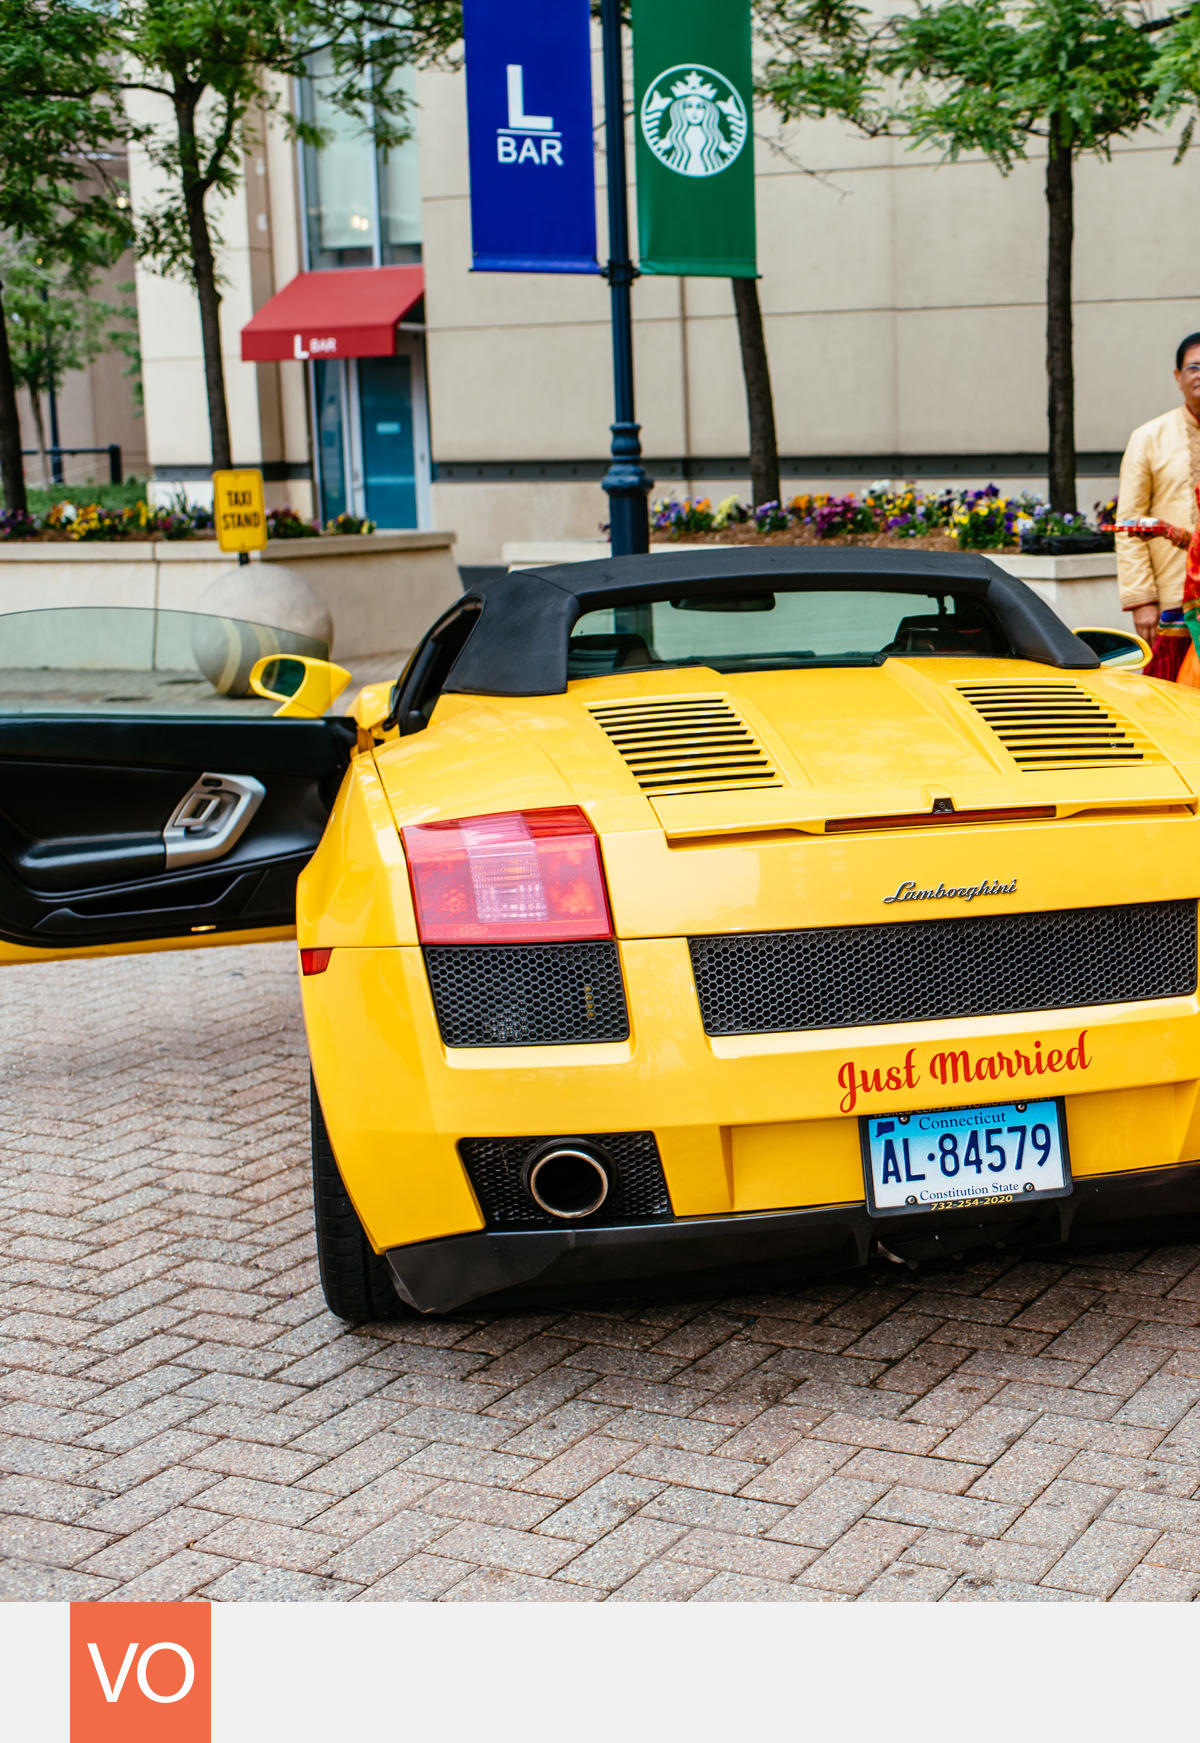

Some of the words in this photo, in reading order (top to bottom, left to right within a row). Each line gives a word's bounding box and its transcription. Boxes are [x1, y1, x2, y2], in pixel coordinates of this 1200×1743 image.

[506, 64, 553, 130] L
[497, 136, 563, 165] BAR
[294, 334, 309, 359] L
[227, 491, 252, 506] TAXI
[222, 513, 260, 530] STAND
[883, 878, 1017, 903] Lamborghini
[838, 1049, 920, 1113] Just
[930, 1030, 1092, 1085] Married
[919, 1112, 1006, 1130] Connecticut
[920, 1187, 988, 1200] Constitution
[992, 1182, 1019, 1192] State
[931, 1195, 1013, 1210] 732-254-2020
